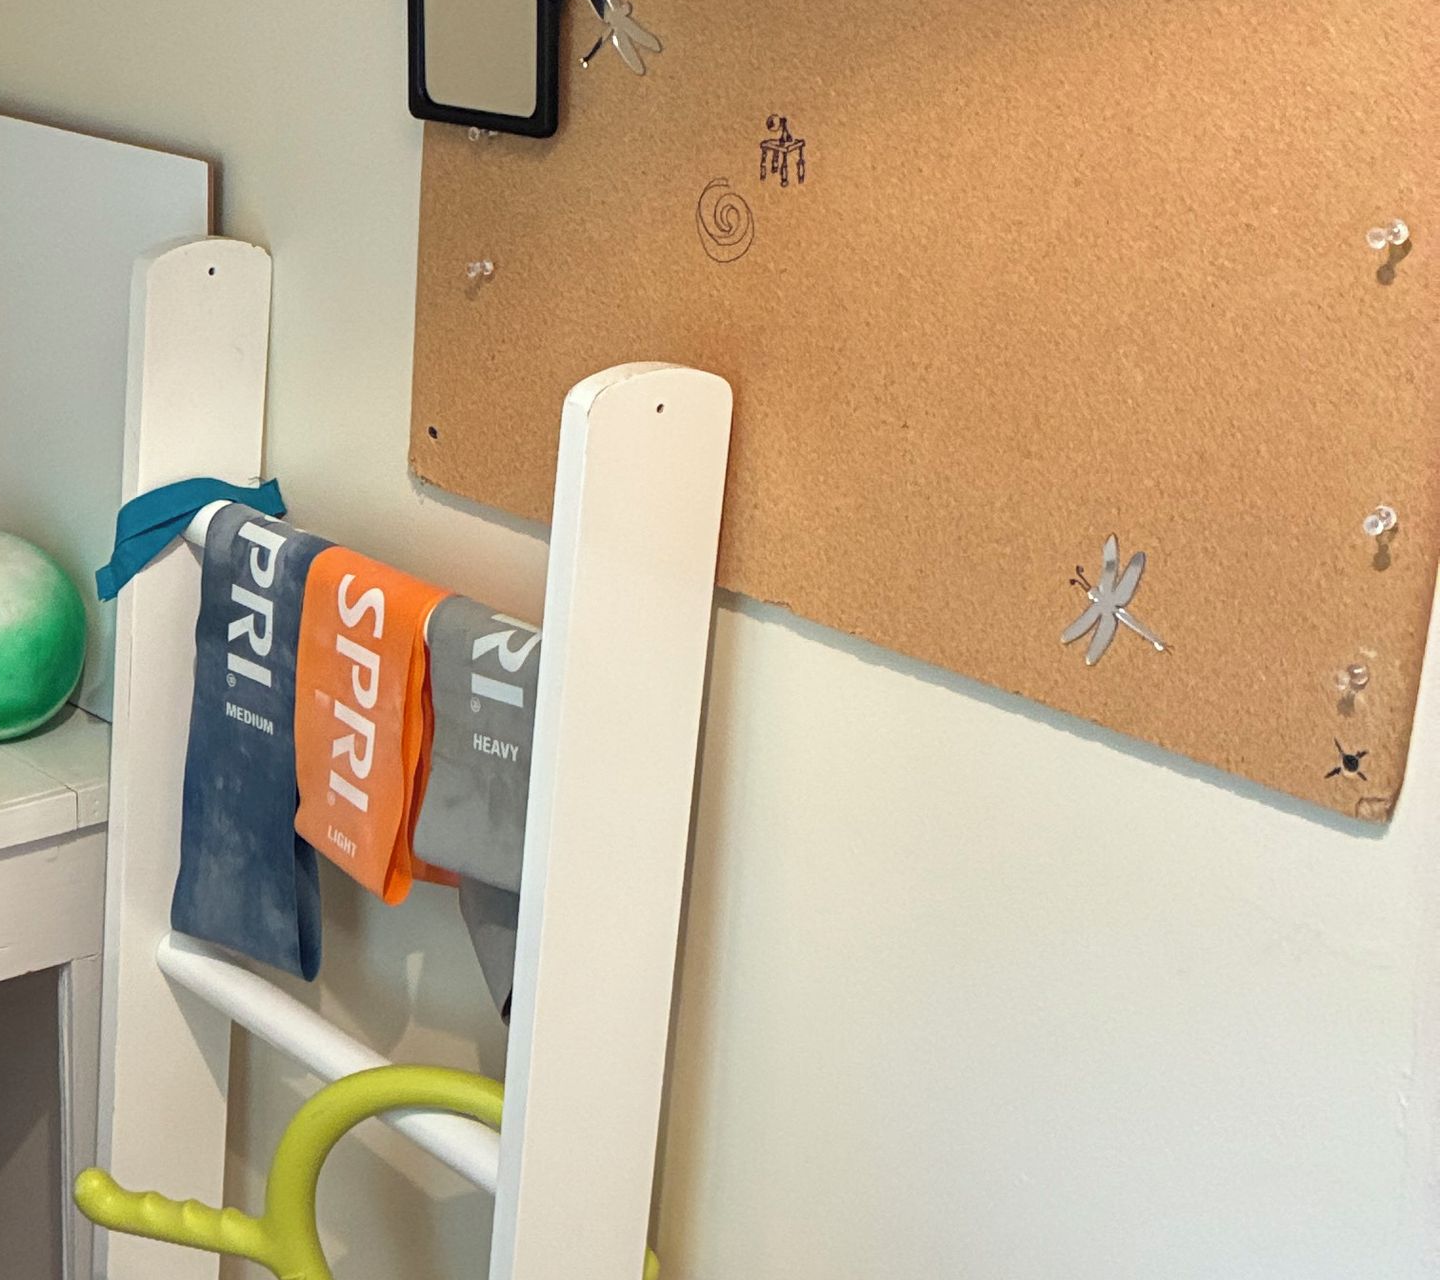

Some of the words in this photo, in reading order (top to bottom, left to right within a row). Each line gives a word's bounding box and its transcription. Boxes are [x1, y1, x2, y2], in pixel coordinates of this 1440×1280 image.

[328, 572, 384, 813] SPRI
[225, 701, 274, 736] MEDIUM
[471, 732, 520, 763] HEAVY
[326, 824, 358, 858] LIGHT
